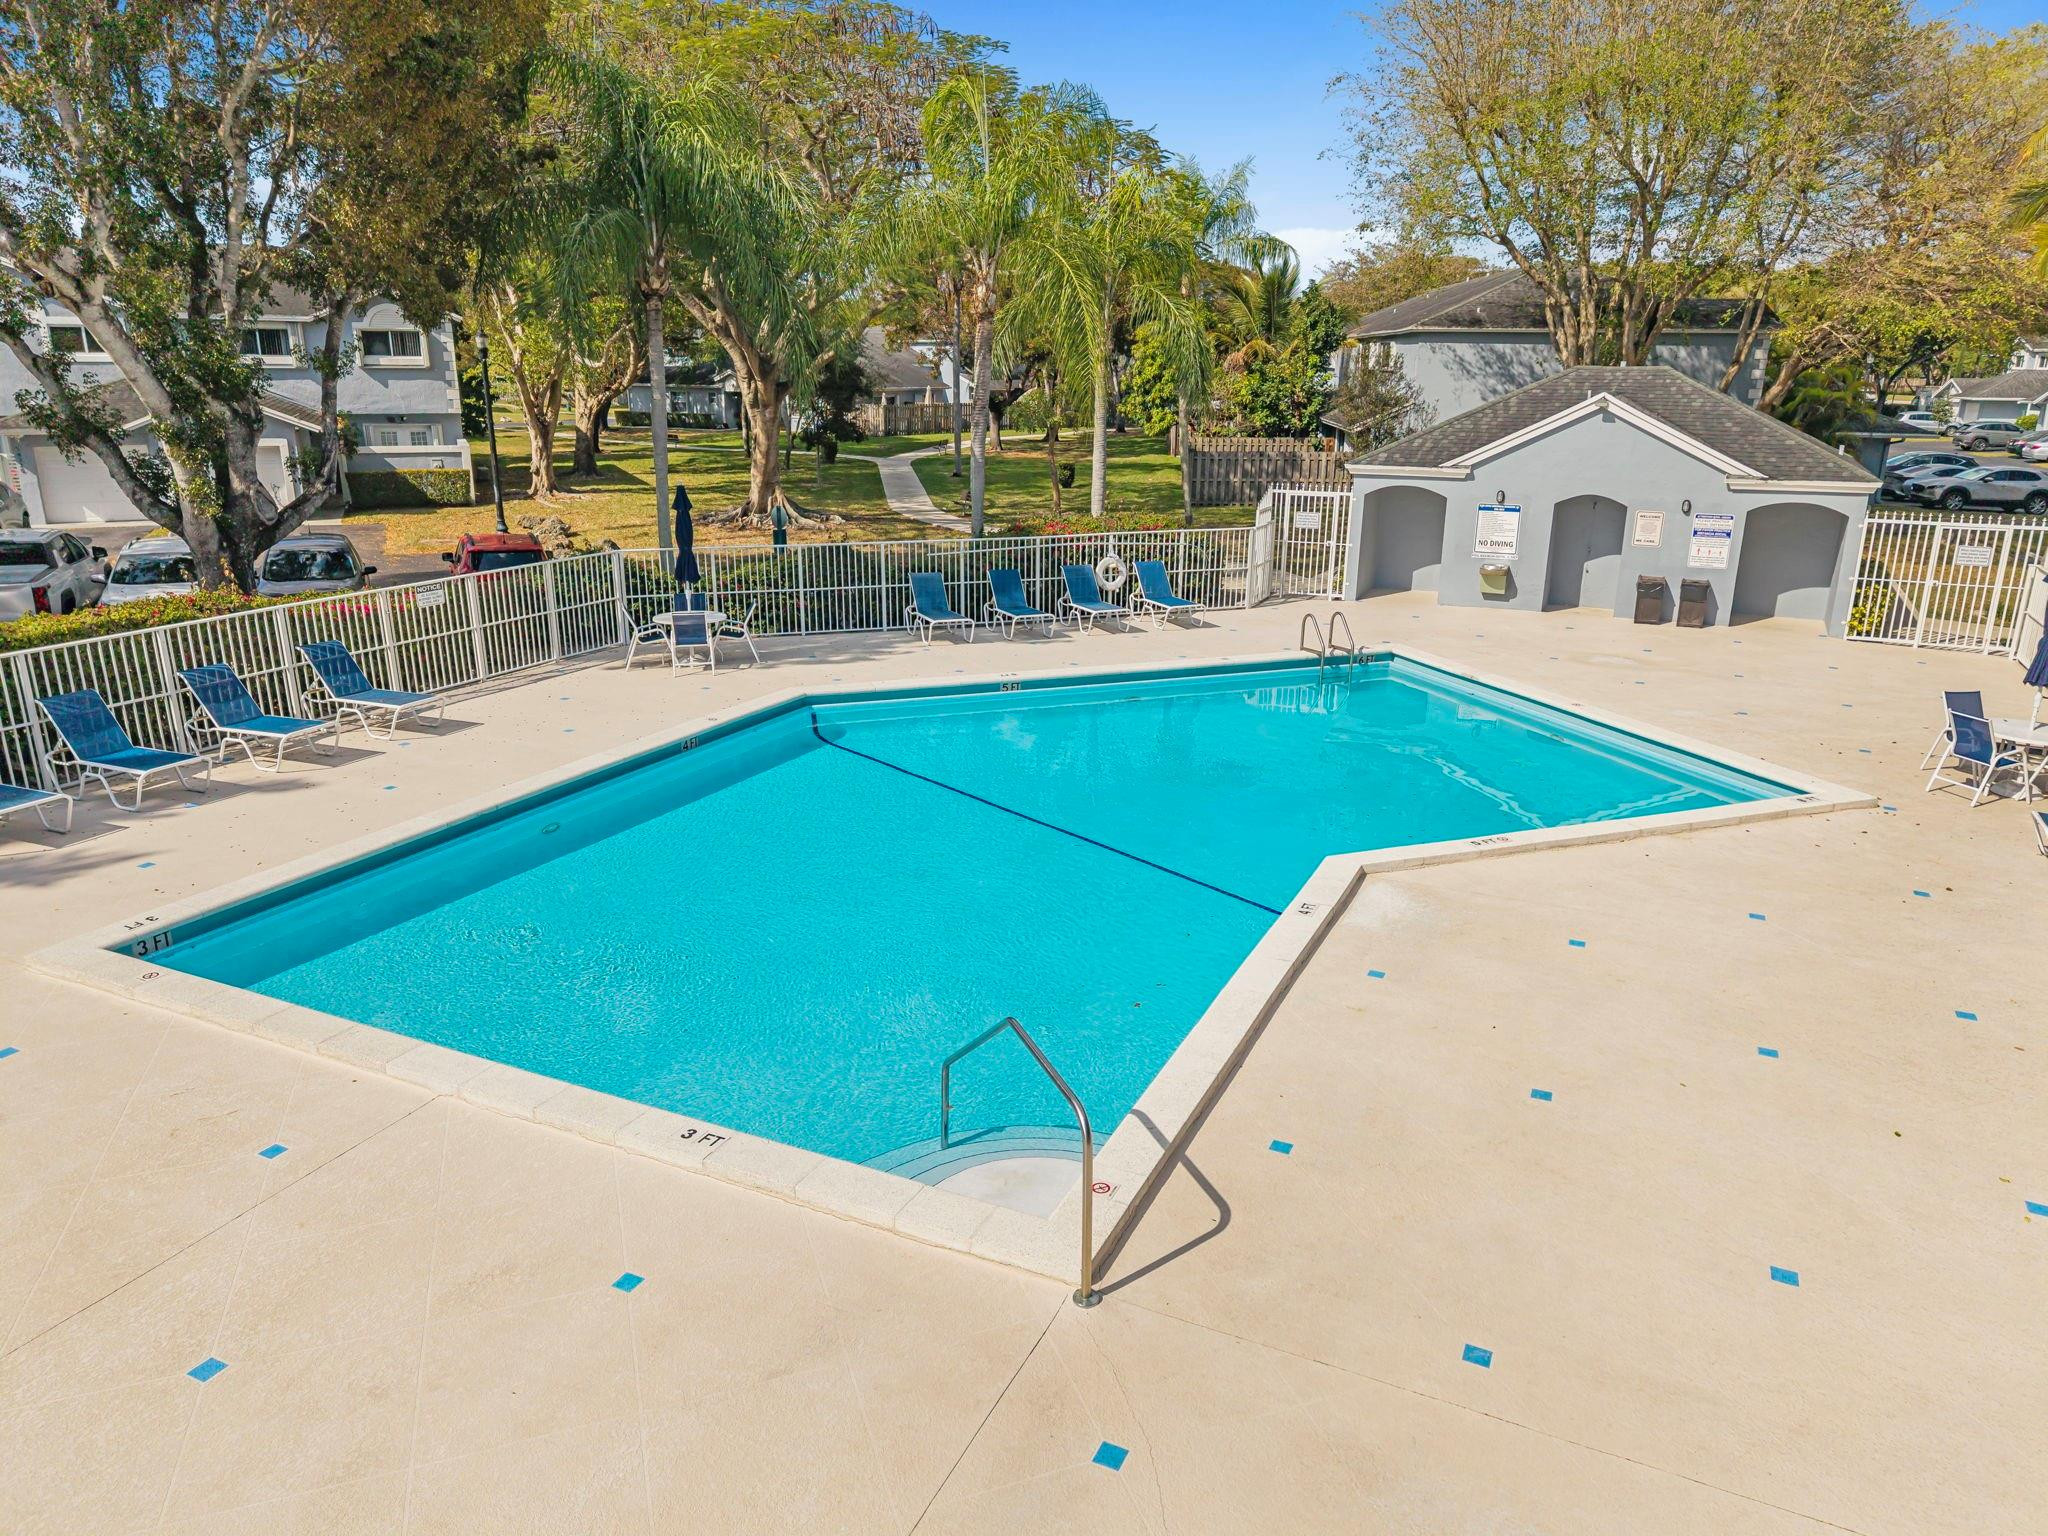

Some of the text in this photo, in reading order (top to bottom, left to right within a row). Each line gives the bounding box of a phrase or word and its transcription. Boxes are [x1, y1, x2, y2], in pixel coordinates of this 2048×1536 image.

[1478, 539, 1514, 548] NO DIVING
[416, 583, 442, 593] NOTICE
[1002, 682, 1020, 691] 5 FT
[682, 740, 689, 750] 4
[136, 930, 170, 957] 3 FT
[680, 1128, 726, 1147] 3 FT
